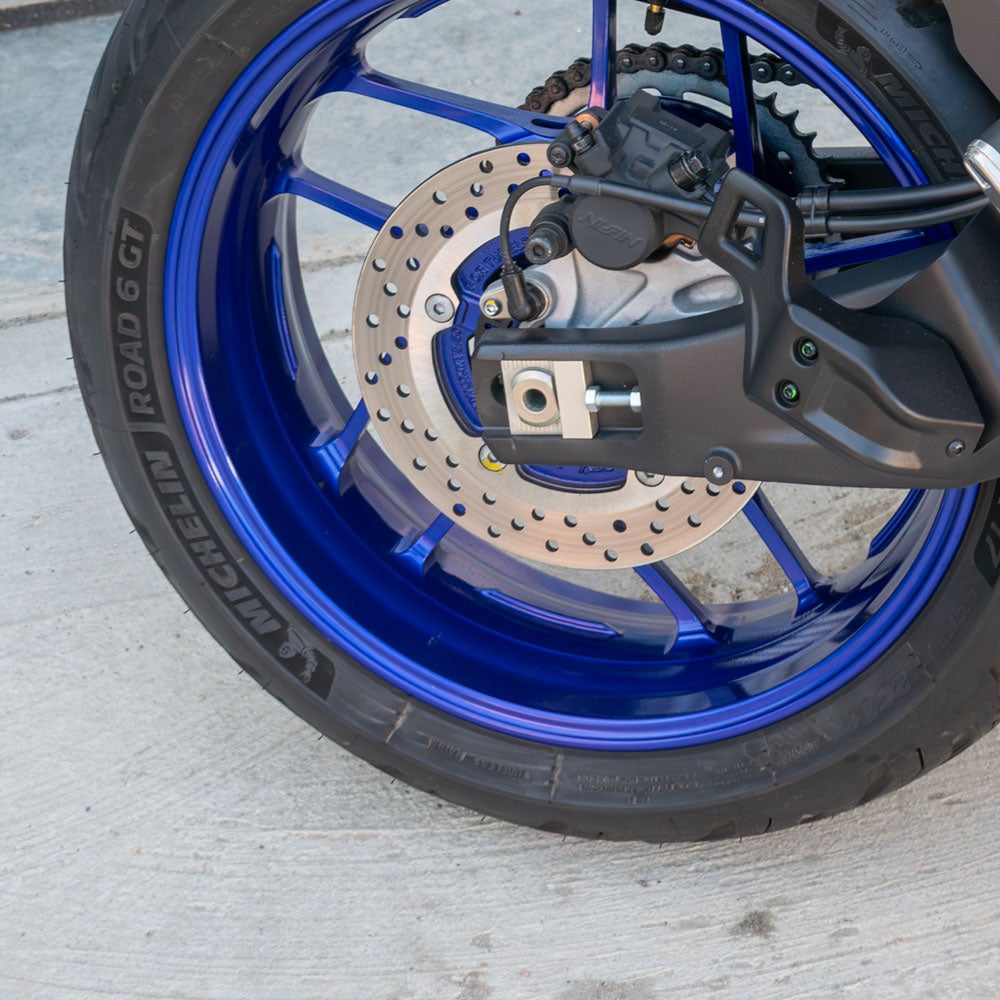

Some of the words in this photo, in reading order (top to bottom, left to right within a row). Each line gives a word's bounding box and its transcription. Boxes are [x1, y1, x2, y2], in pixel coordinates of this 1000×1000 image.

[873, 72, 970, 178] MICH
[115, 276, 141, 300] 6
[118, 217, 148, 275] GT
[116, 310, 157, 417] ROAD
[144, 449, 283, 638] MICHELIN
